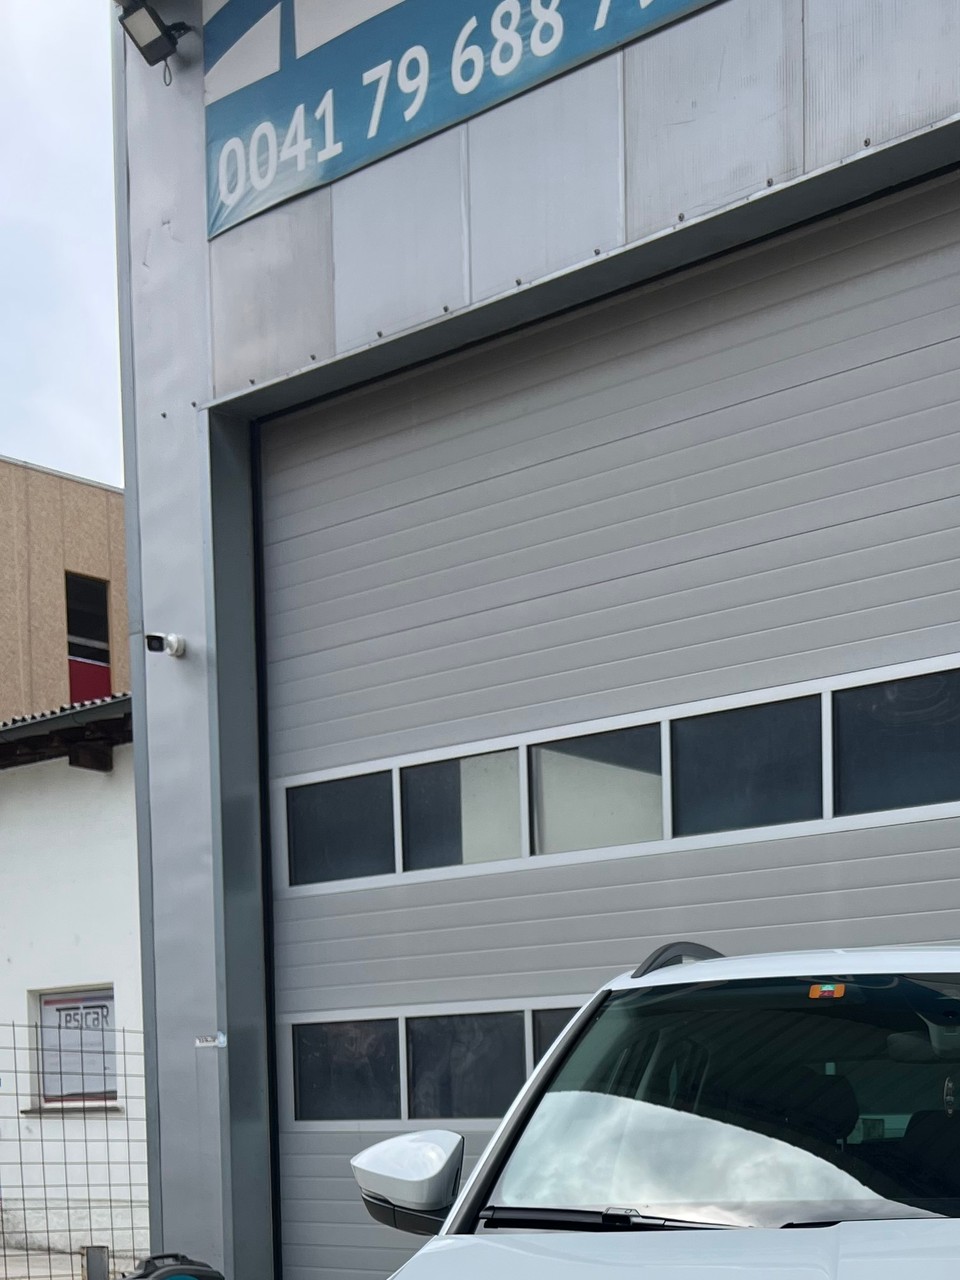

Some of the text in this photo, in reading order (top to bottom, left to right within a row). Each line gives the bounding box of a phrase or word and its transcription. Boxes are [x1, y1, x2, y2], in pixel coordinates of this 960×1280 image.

[218, 0, 564, 207] 0041 79 688
